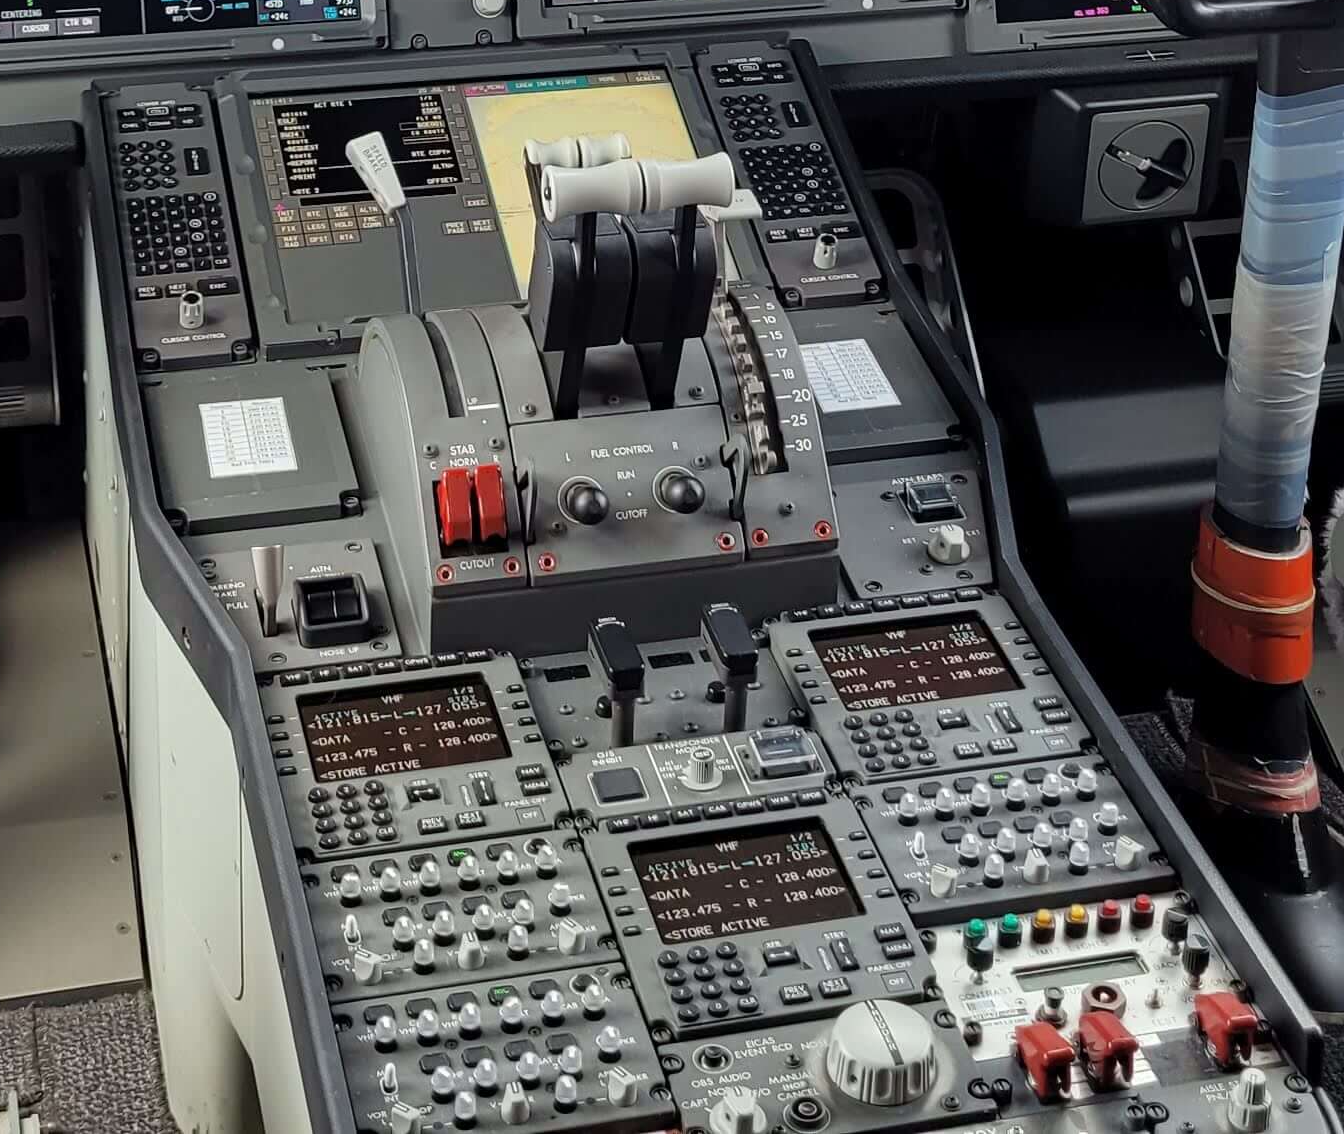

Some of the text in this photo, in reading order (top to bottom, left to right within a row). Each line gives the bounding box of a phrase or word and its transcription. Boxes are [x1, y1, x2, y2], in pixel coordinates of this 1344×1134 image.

[22, 24, 50, 33] CURSOR
[766, 302, 775, 311] 5
[763, 315, 777, 324] 10
[192, 333, 226, 341] CONTROL
[769, 331, 783, 340] 15
[775, 348, 788, 359] 17
[782, 369, 795, 379] 18
[792, 389, 811, 403] 20
[790, 414, 808, 426] 25
[450, 444, 475, 457] STAB
[794, 439, 812, 451] 30
[566, 441, 678, 462] L FUEL CONTROL R
[430, 456, 479, 470] C NORM
[617, 469, 636, 480] RUN
[615, 508, 648, 521] CUTOFF
[311, 564, 331, 573] ALTN
[460, 558, 495, 570] CUTOUT
[225, 602, 248, 611] PULL
[886, 630, 906, 640] VHF
[319, 647, 359, 657] NOSE UP
[381, 695, 404, 704] VHF
[897, 690, 940, 704] ACTIVE
[1050, 739, 1064, 747] OFF
[374, 759, 422, 773] ACTIVE
[523, 811, 539, 819] OFF
[790, 832, 812, 841] 1/2
[715, 841, 739, 853] VHF
[740, 878, 750, 889] C
[747, 898, 757, 908] R
[721, 917, 769, 932] ACTIVE
[880, 926, 900, 935] NAV
[889, 977, 904, 986] OFF
[746, 1037, 776, 1047] EICAS
[734, 1042, 792, 1059] EVENT RCD
[718, 1071, 751, 1083] AUDIO
[777, 1088, 820, 1101] CANCEL
[681, 1097, 708, 1109] CAPT
